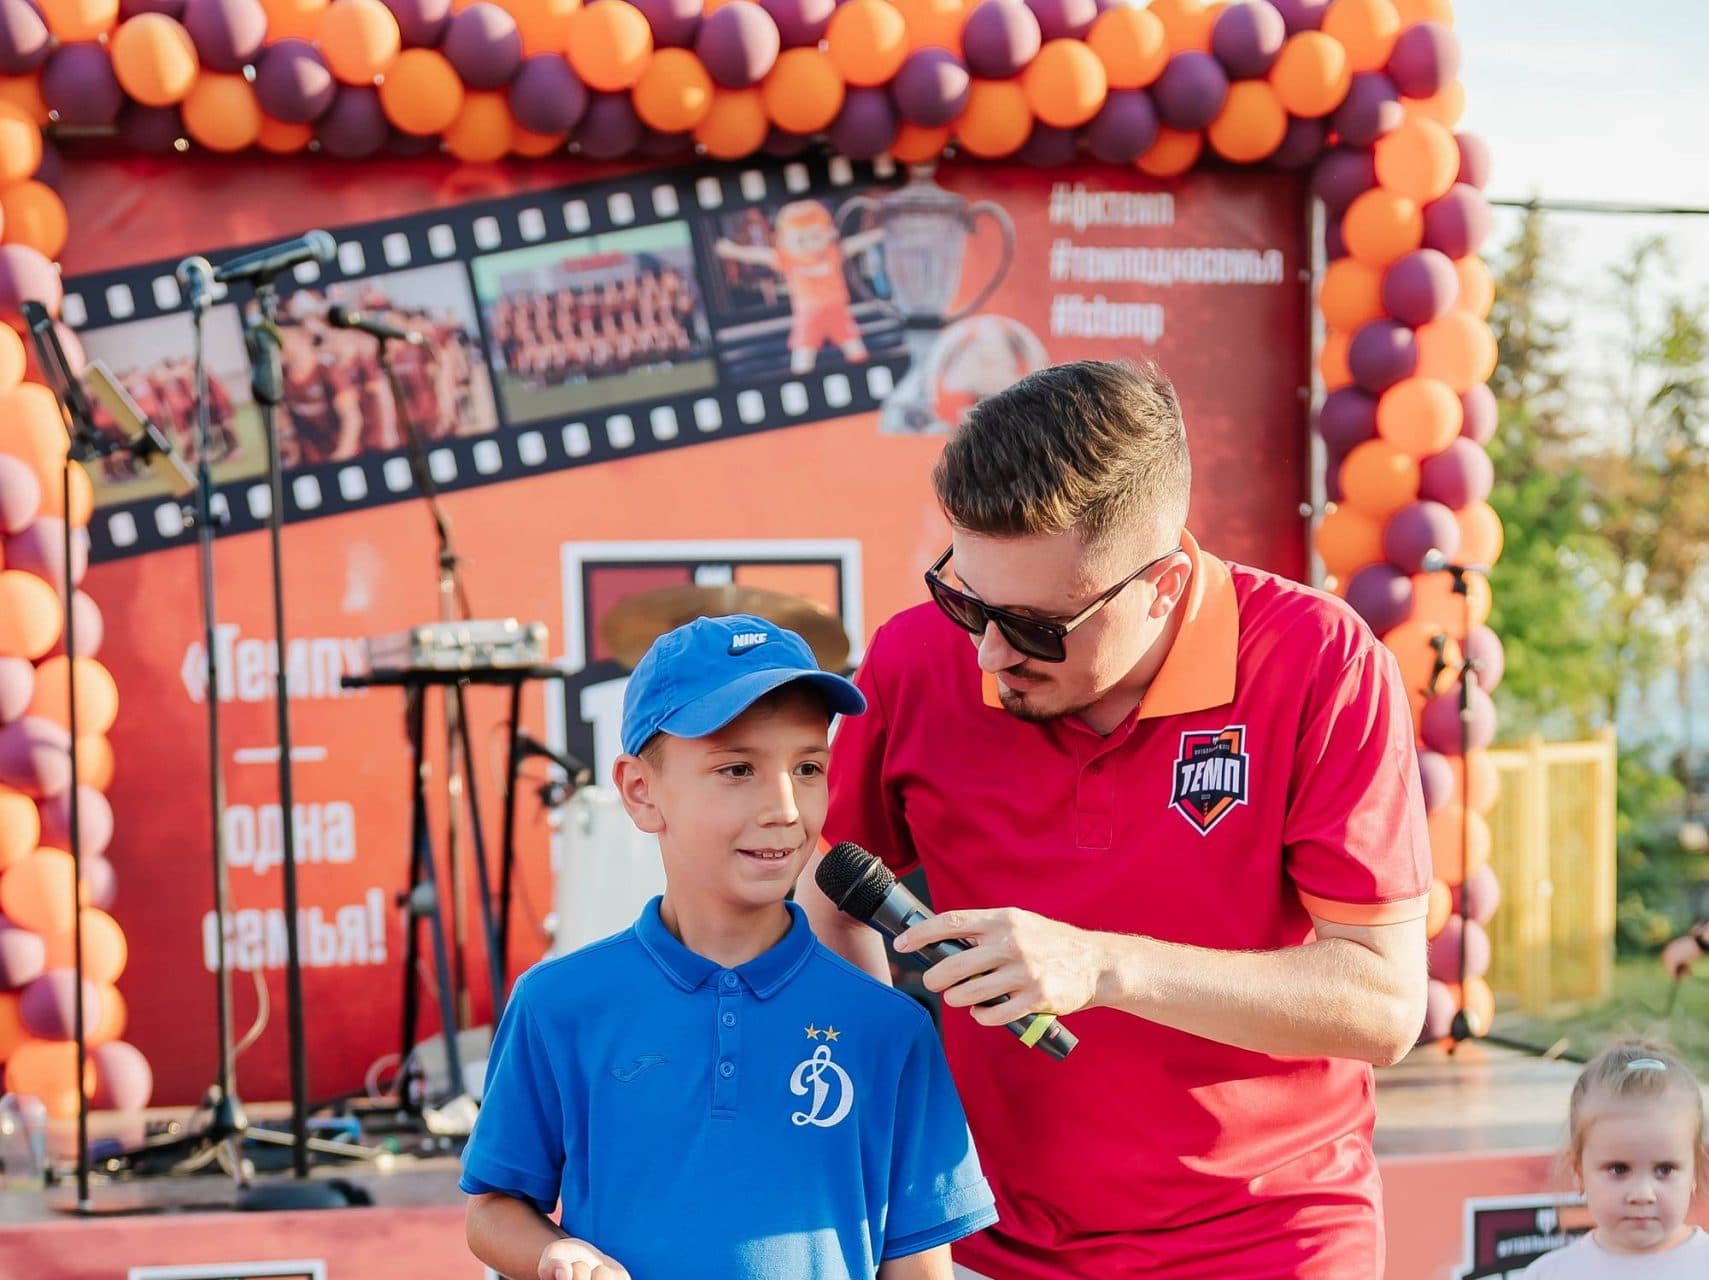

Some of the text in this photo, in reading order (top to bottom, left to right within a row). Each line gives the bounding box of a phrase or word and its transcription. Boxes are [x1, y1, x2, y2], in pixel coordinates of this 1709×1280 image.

[732, 633, 768, 648] NIKE
[1180, 757, 1240, 796] ТЕМП
[222, 801, 356, 875] одна
[202, 887, 388, 972] семья!
